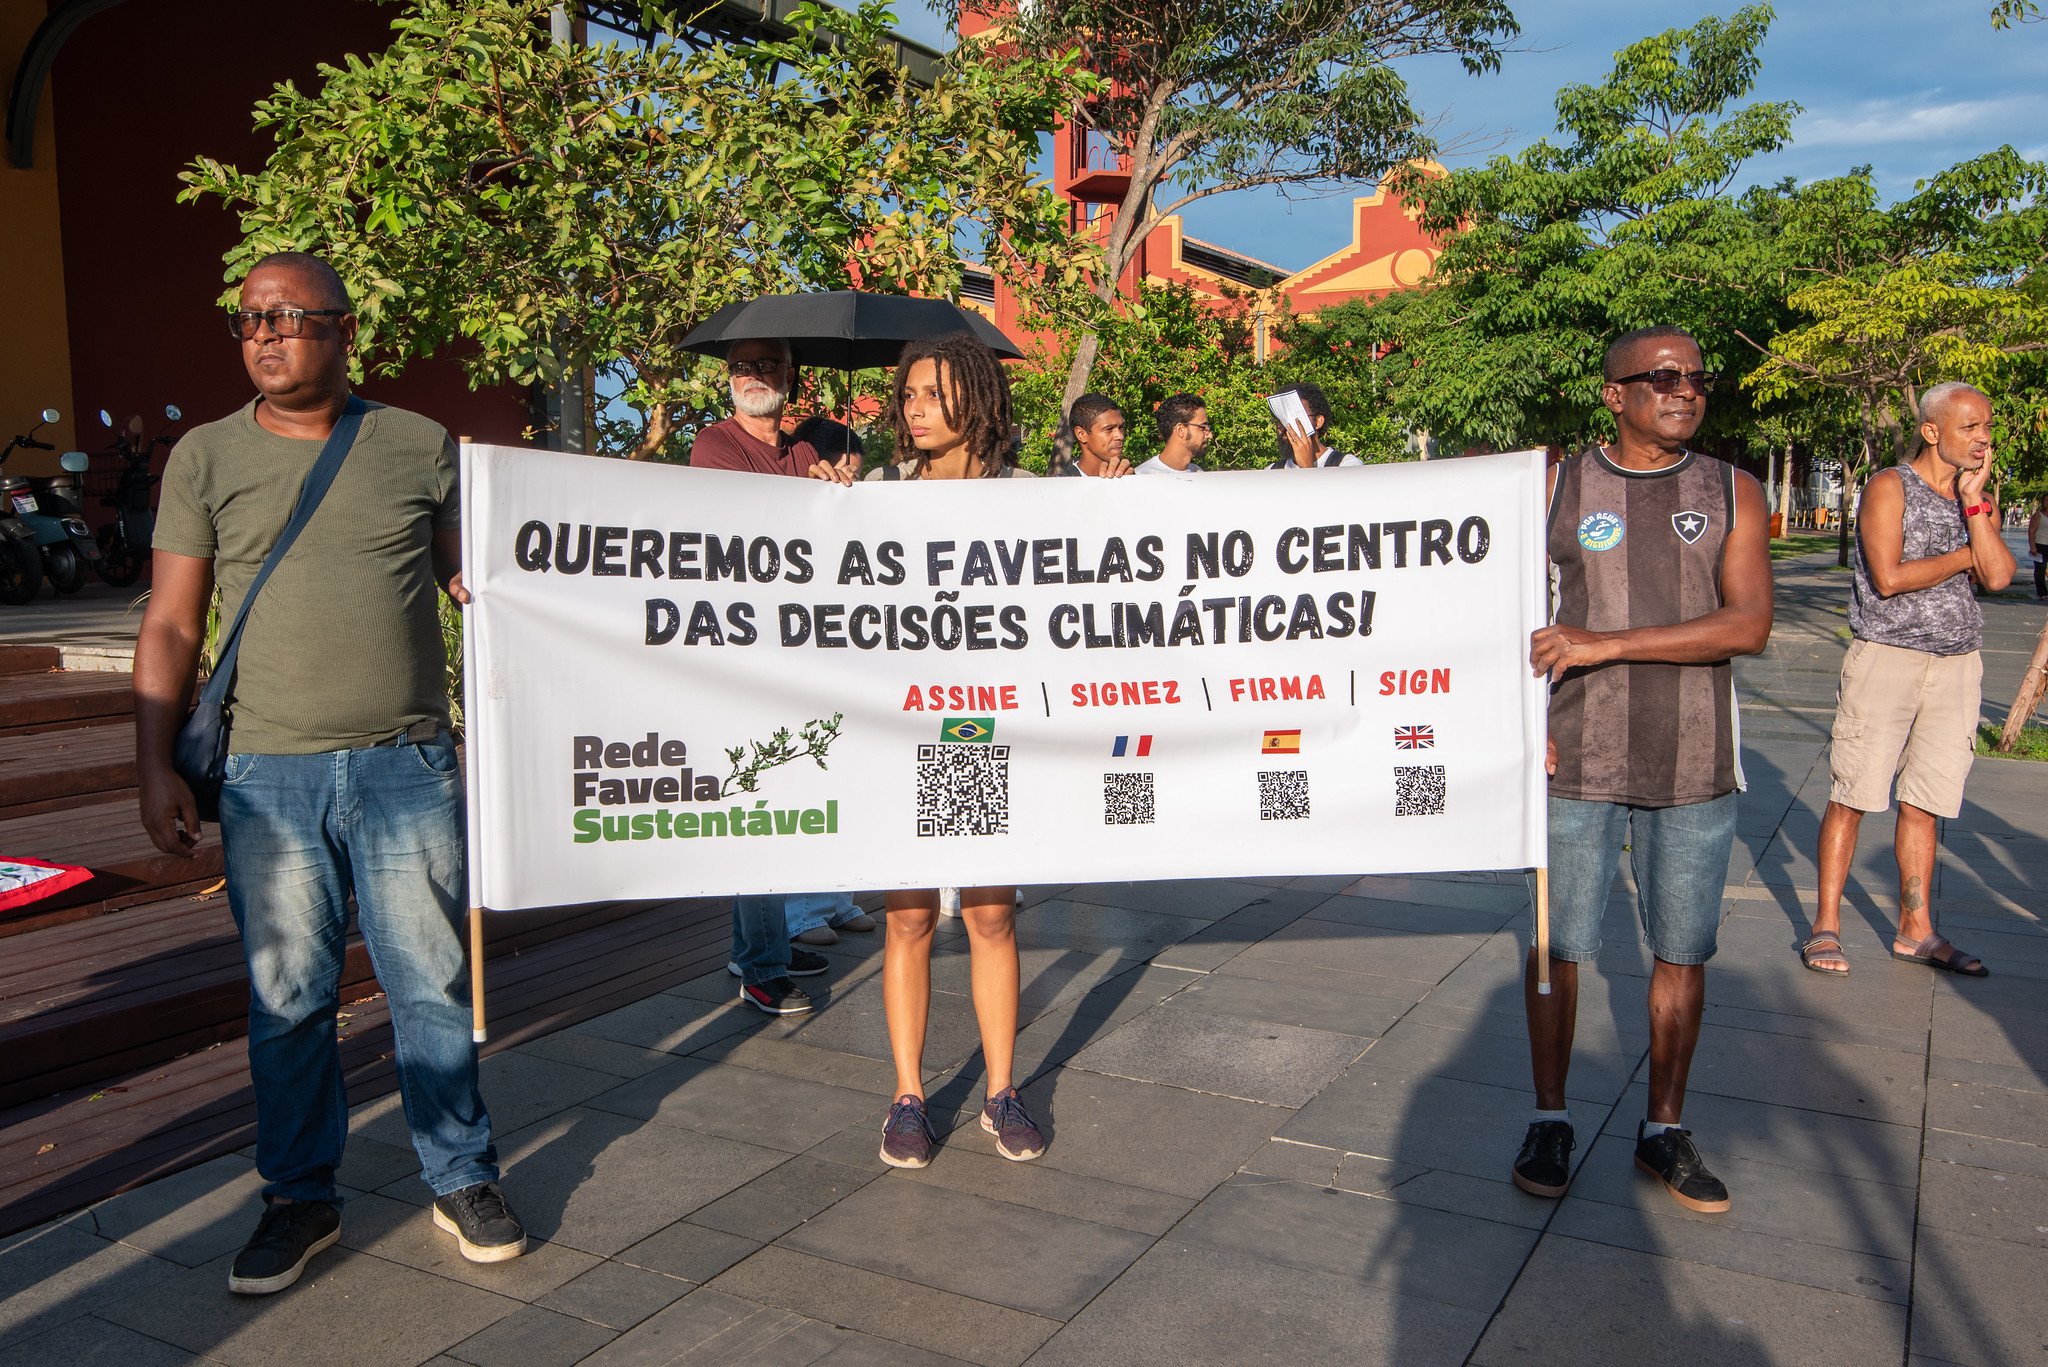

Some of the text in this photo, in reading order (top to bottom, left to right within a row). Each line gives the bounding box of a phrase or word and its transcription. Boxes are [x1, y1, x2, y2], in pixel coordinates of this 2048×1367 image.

[1580, 515, 1596, 530] POR
[515, 515, 1491, 587] QUEREMOS AS FAVELAS NO CENTRO
[1584, 527, 1622, 549] DIGNIDADE
[645, 585, 1377, 650] DAS DECISÕES CLIMÁTICAS!
[1071, 681, 1181, 707] SIGNEZ
[1230, 675, 1325, 702] FIRMA
[1379, 668, 1451, 695] SIGN
[903, 685, 1019, 711] ASSINE
[573, 732, 687, 770] Rede
[573, 767, 721, 806] Favela
[573, 800, 839, 843] Sustentável
